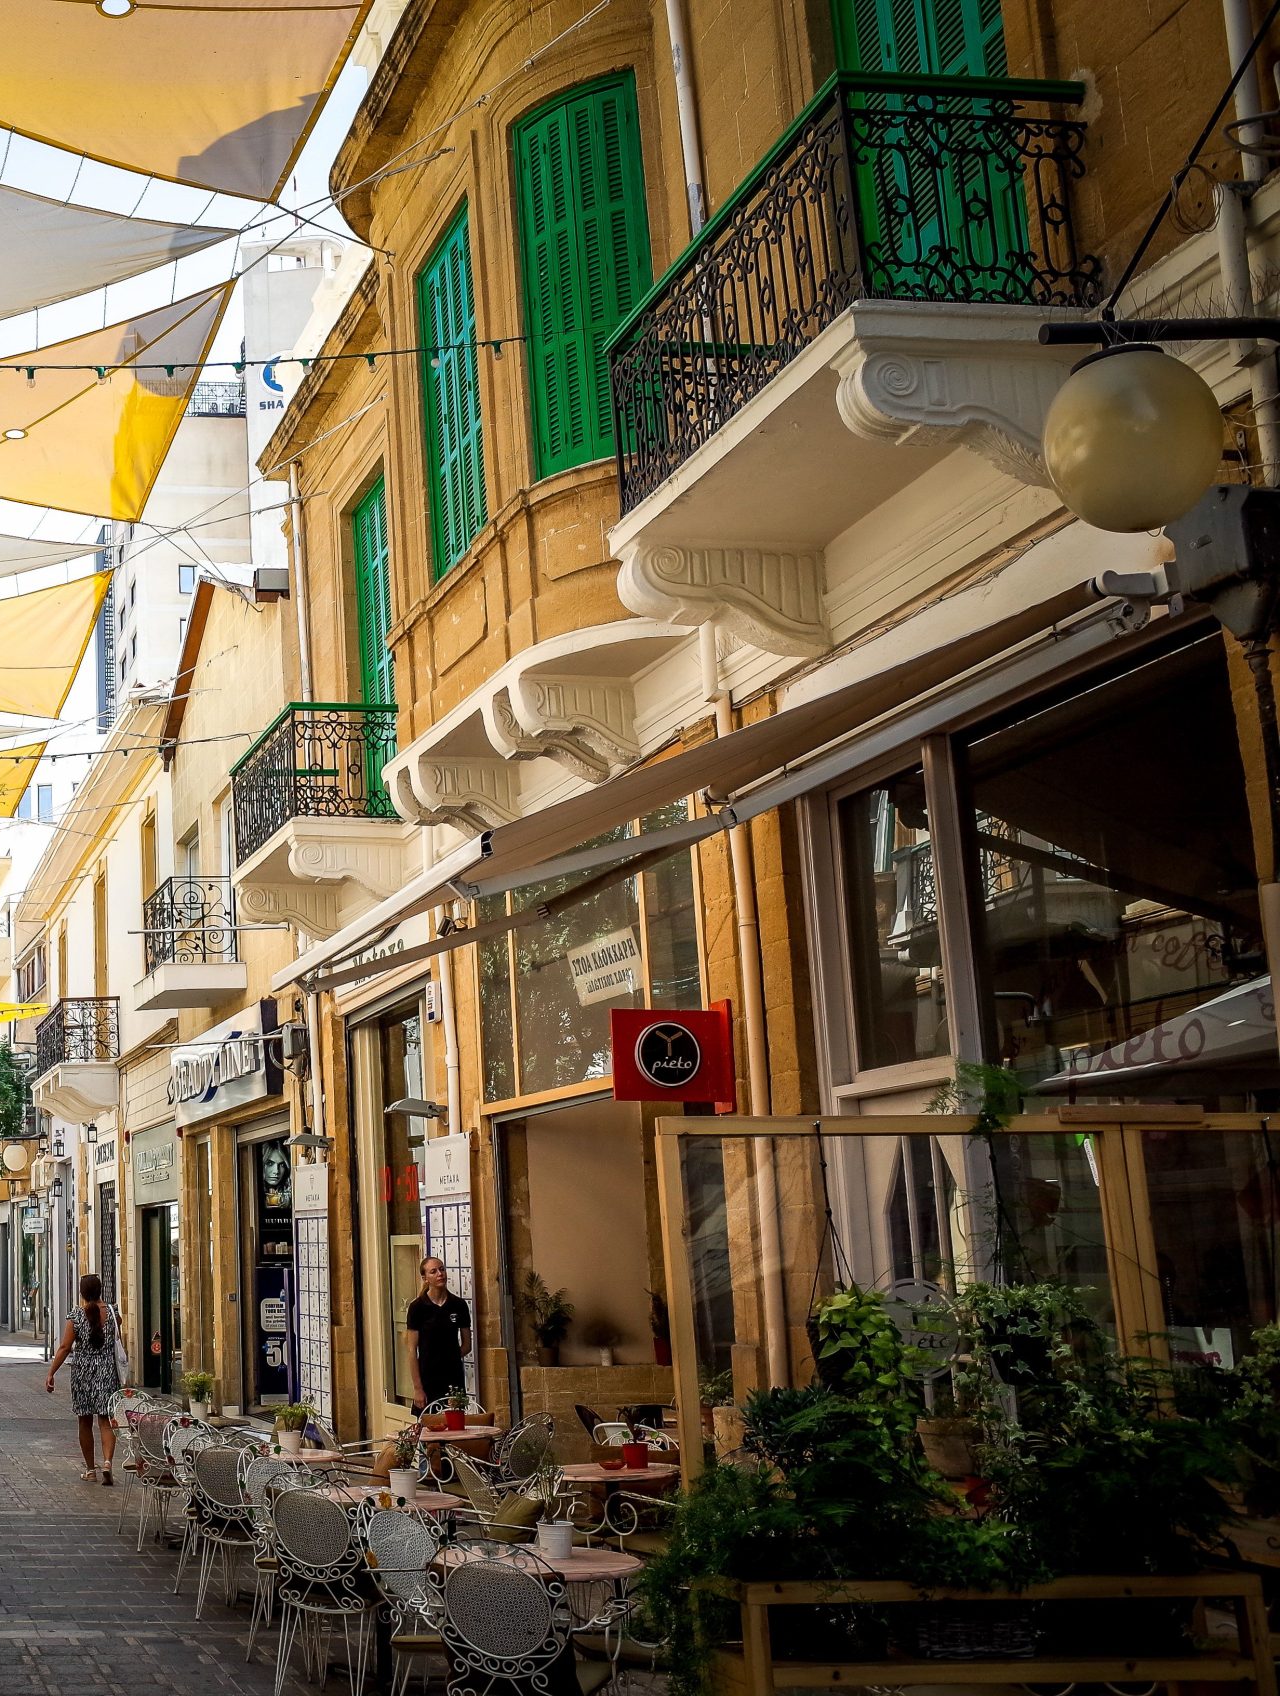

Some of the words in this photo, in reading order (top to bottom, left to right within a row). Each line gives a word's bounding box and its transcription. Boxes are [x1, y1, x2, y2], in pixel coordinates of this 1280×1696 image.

[571, 955, 594, 977] ΣΤΟΑ
[173, 1050, 221, 1103] BEAUTY
[219, 1037, 258, 1085] LINE
[651, 1056, 692, 1074] pieto
